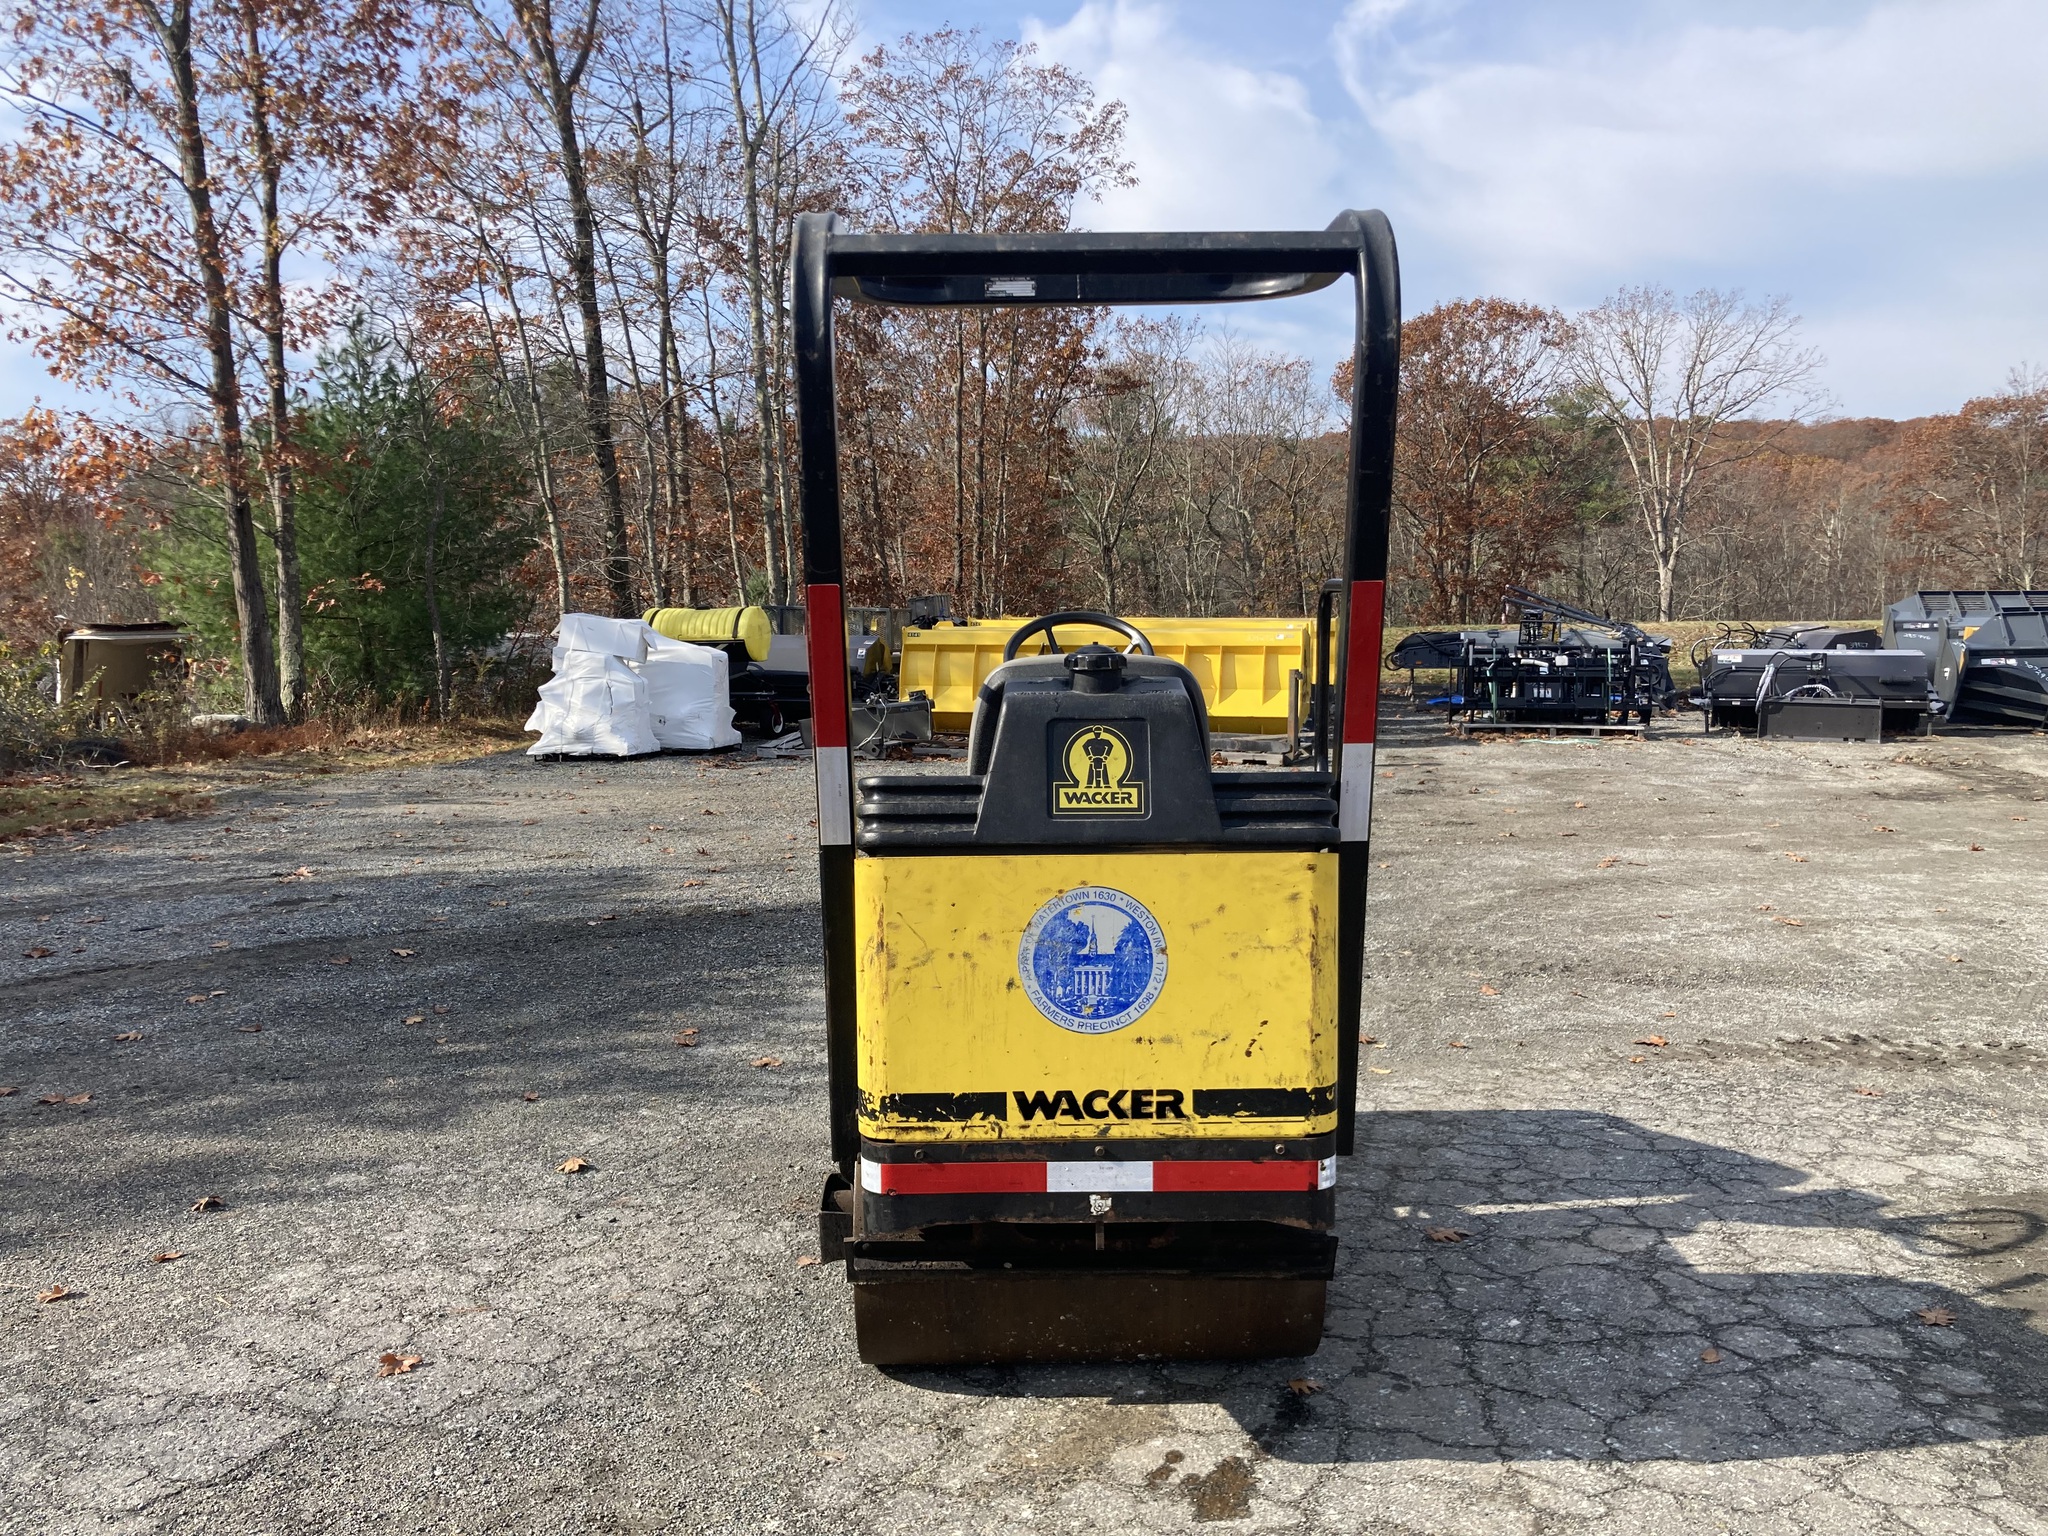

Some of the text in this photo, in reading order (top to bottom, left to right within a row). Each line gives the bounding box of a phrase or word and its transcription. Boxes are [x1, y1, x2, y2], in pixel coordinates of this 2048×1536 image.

[1063, 791, 1133, 805] WACKER
[1034, 891, 1089, 928] WATERTOWN
[1093, 891, 1117, 901] 1630
[1126, 900, 1157, 935] WESTON
[1152, 961, 1164, 984] 1712
[1031, 990, 1155, 1030] FARMERS PRECINCT 1698
[1012, 1089, 1188, 1121] WACKER
